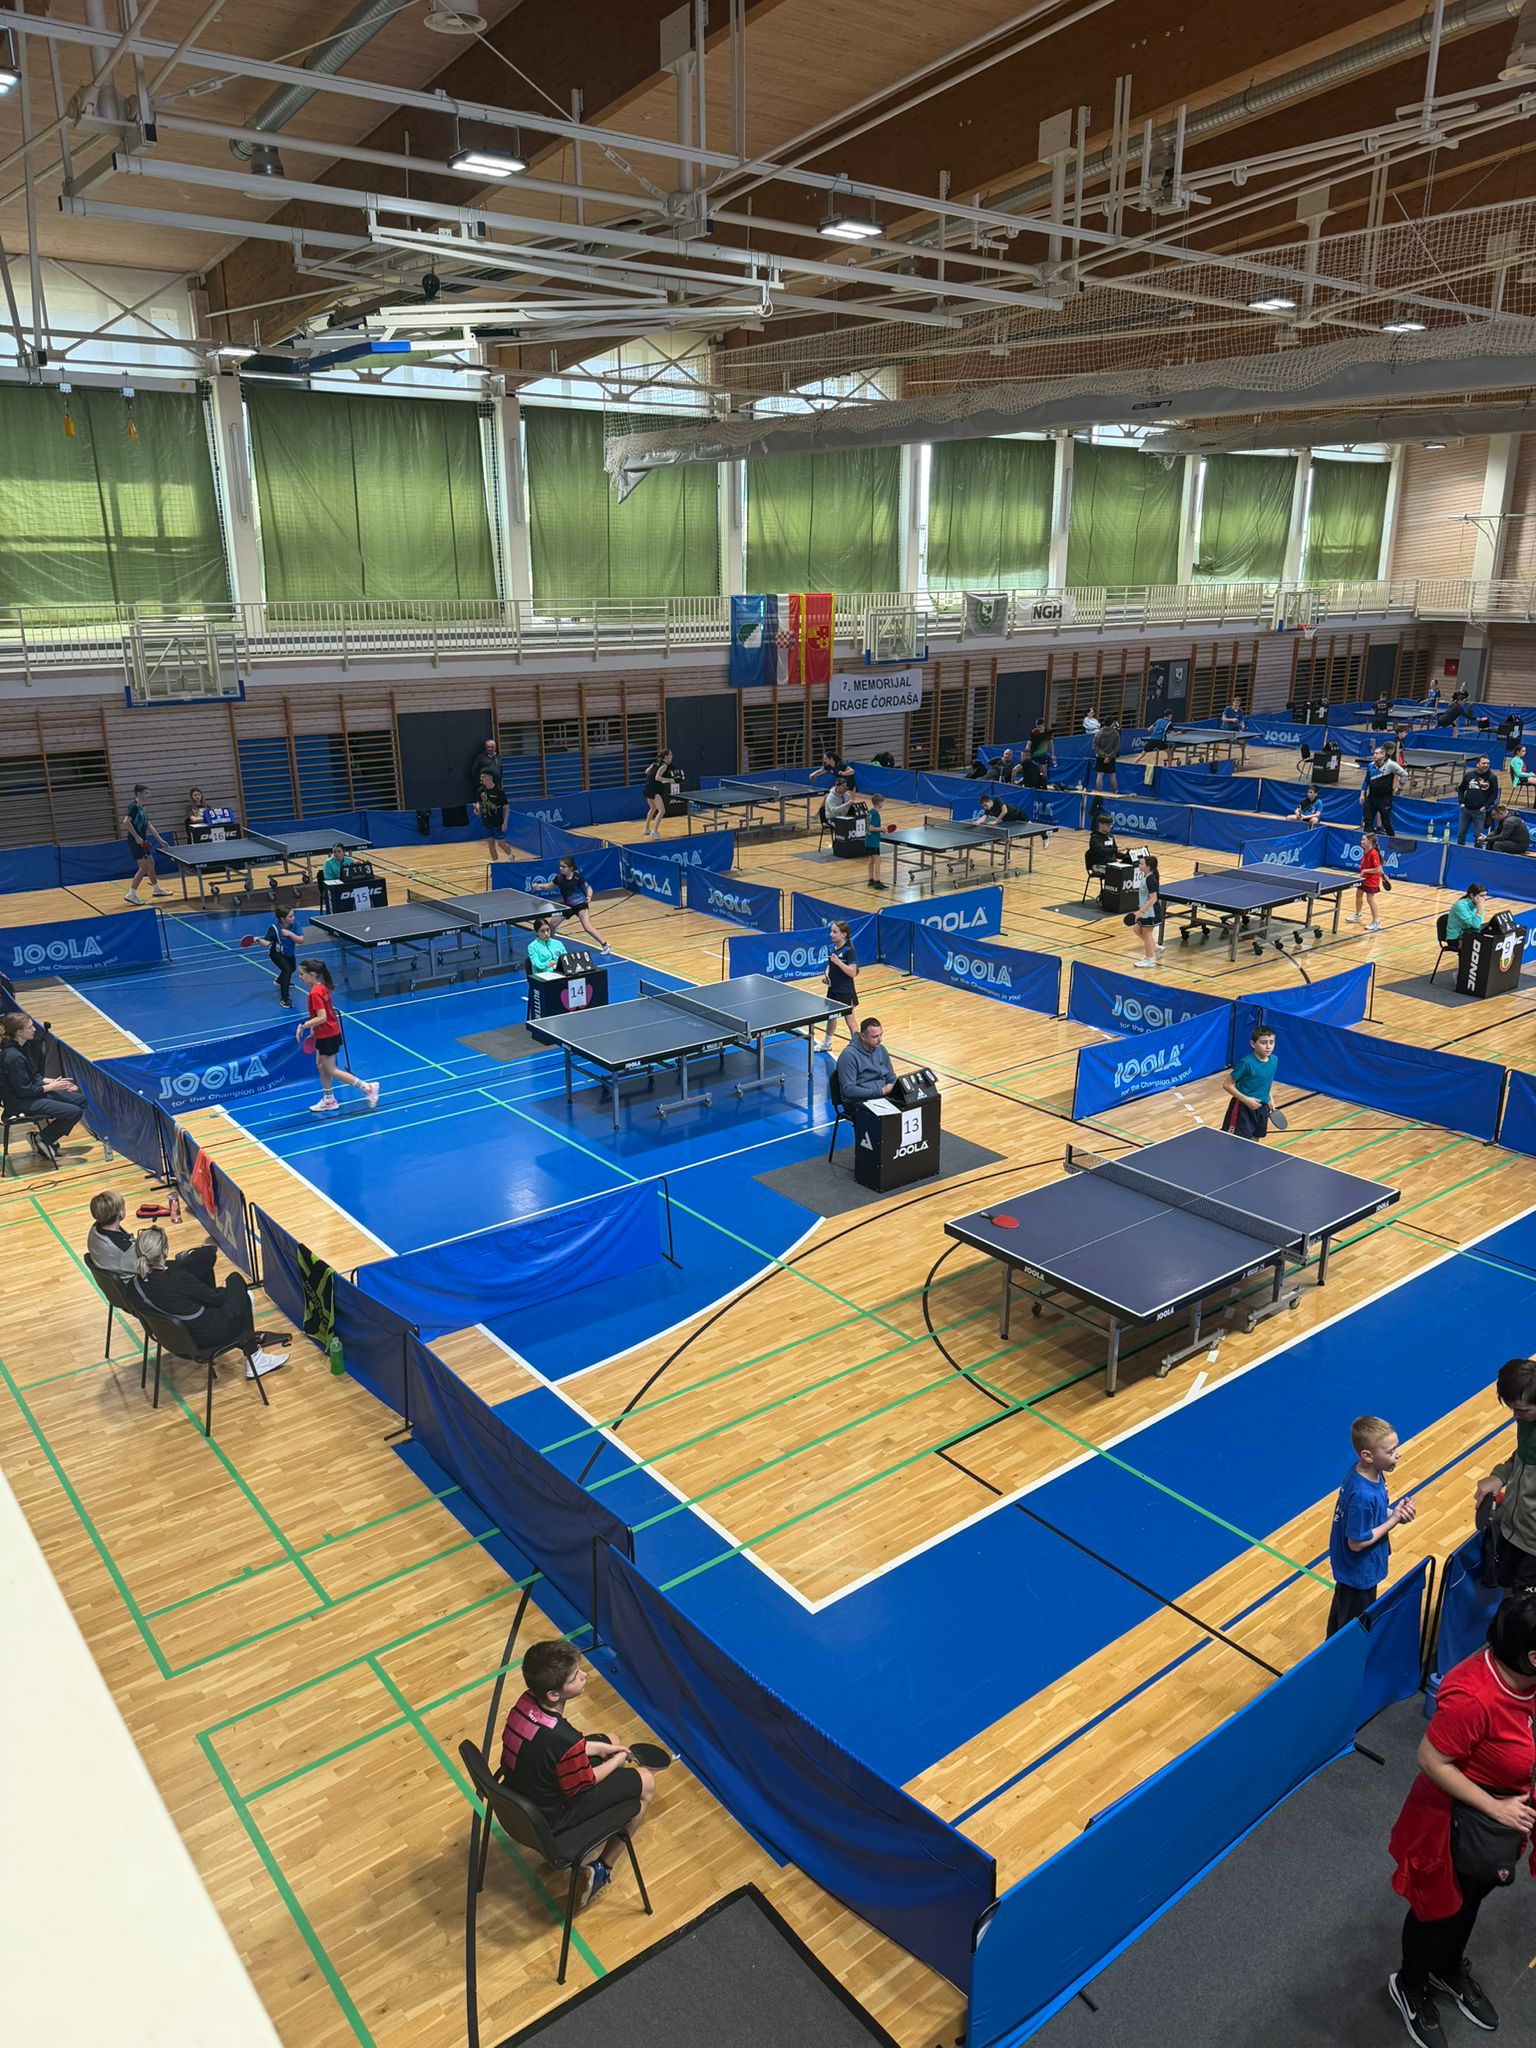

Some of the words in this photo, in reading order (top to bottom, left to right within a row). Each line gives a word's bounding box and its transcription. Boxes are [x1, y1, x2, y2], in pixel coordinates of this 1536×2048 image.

[1132, 401, 1172, 410] elan
[1033, 605, 1062, 619] NGH
[843, 681, 851, 691] 7.
[854, 676, 911, 692] MEMORIJAL
[831, 698, 868, 712] DRAGE
[871, 693, 919, 710] ČORDAŠA
[1264, 730, 1300, 743] JOOLA
[1110, 811, 1158, 831] JOOLA
[214, 832, 224, 840] 16
[1134, 872, 1144, 882] 10
[356, 893, 368, 903] 15
[13, 936, 104, 967] JOOLA
[1504, 941, 1511, 954] 9
[24, 967, 37, 975] for
[53, 963, 93, 971] Champion
[103, 956, 118, 967] you!
[766, 945, 828, 973] JOOLA
[1467, 939, 1482, 992] DONIC
[944, 951, 1012, 988] JOOLA
[570, 985, 584, 998] 14
[533, 988, 542, 1020] BUTTER
[1132, 1023, 1144, 1033] the
[1114, 1044, 1182, 1088] JOOLA
[158, 1055, 269, 1100] JOOLA
[1131, 1083, 1140, 1092] the
[1141, 1076, 1171, 1088] Champion
[1179, 1068, 1193, 1081] you!
[171, 1098, 187, 1109] for
[190, 1095, 206, 1103] the
[208, 1087, 255, 1101] Champion
[256, 1084, 266, 1093] in
[267, 1075, 286, 1090] you!
[904, 1118, 919, 1135] 13
[893, 1141, 929, 1160] JOOLA
[1024, 1265, 1045, 1281] JOOLA
[1156, 1307, 1175, 1321] JOOLA
